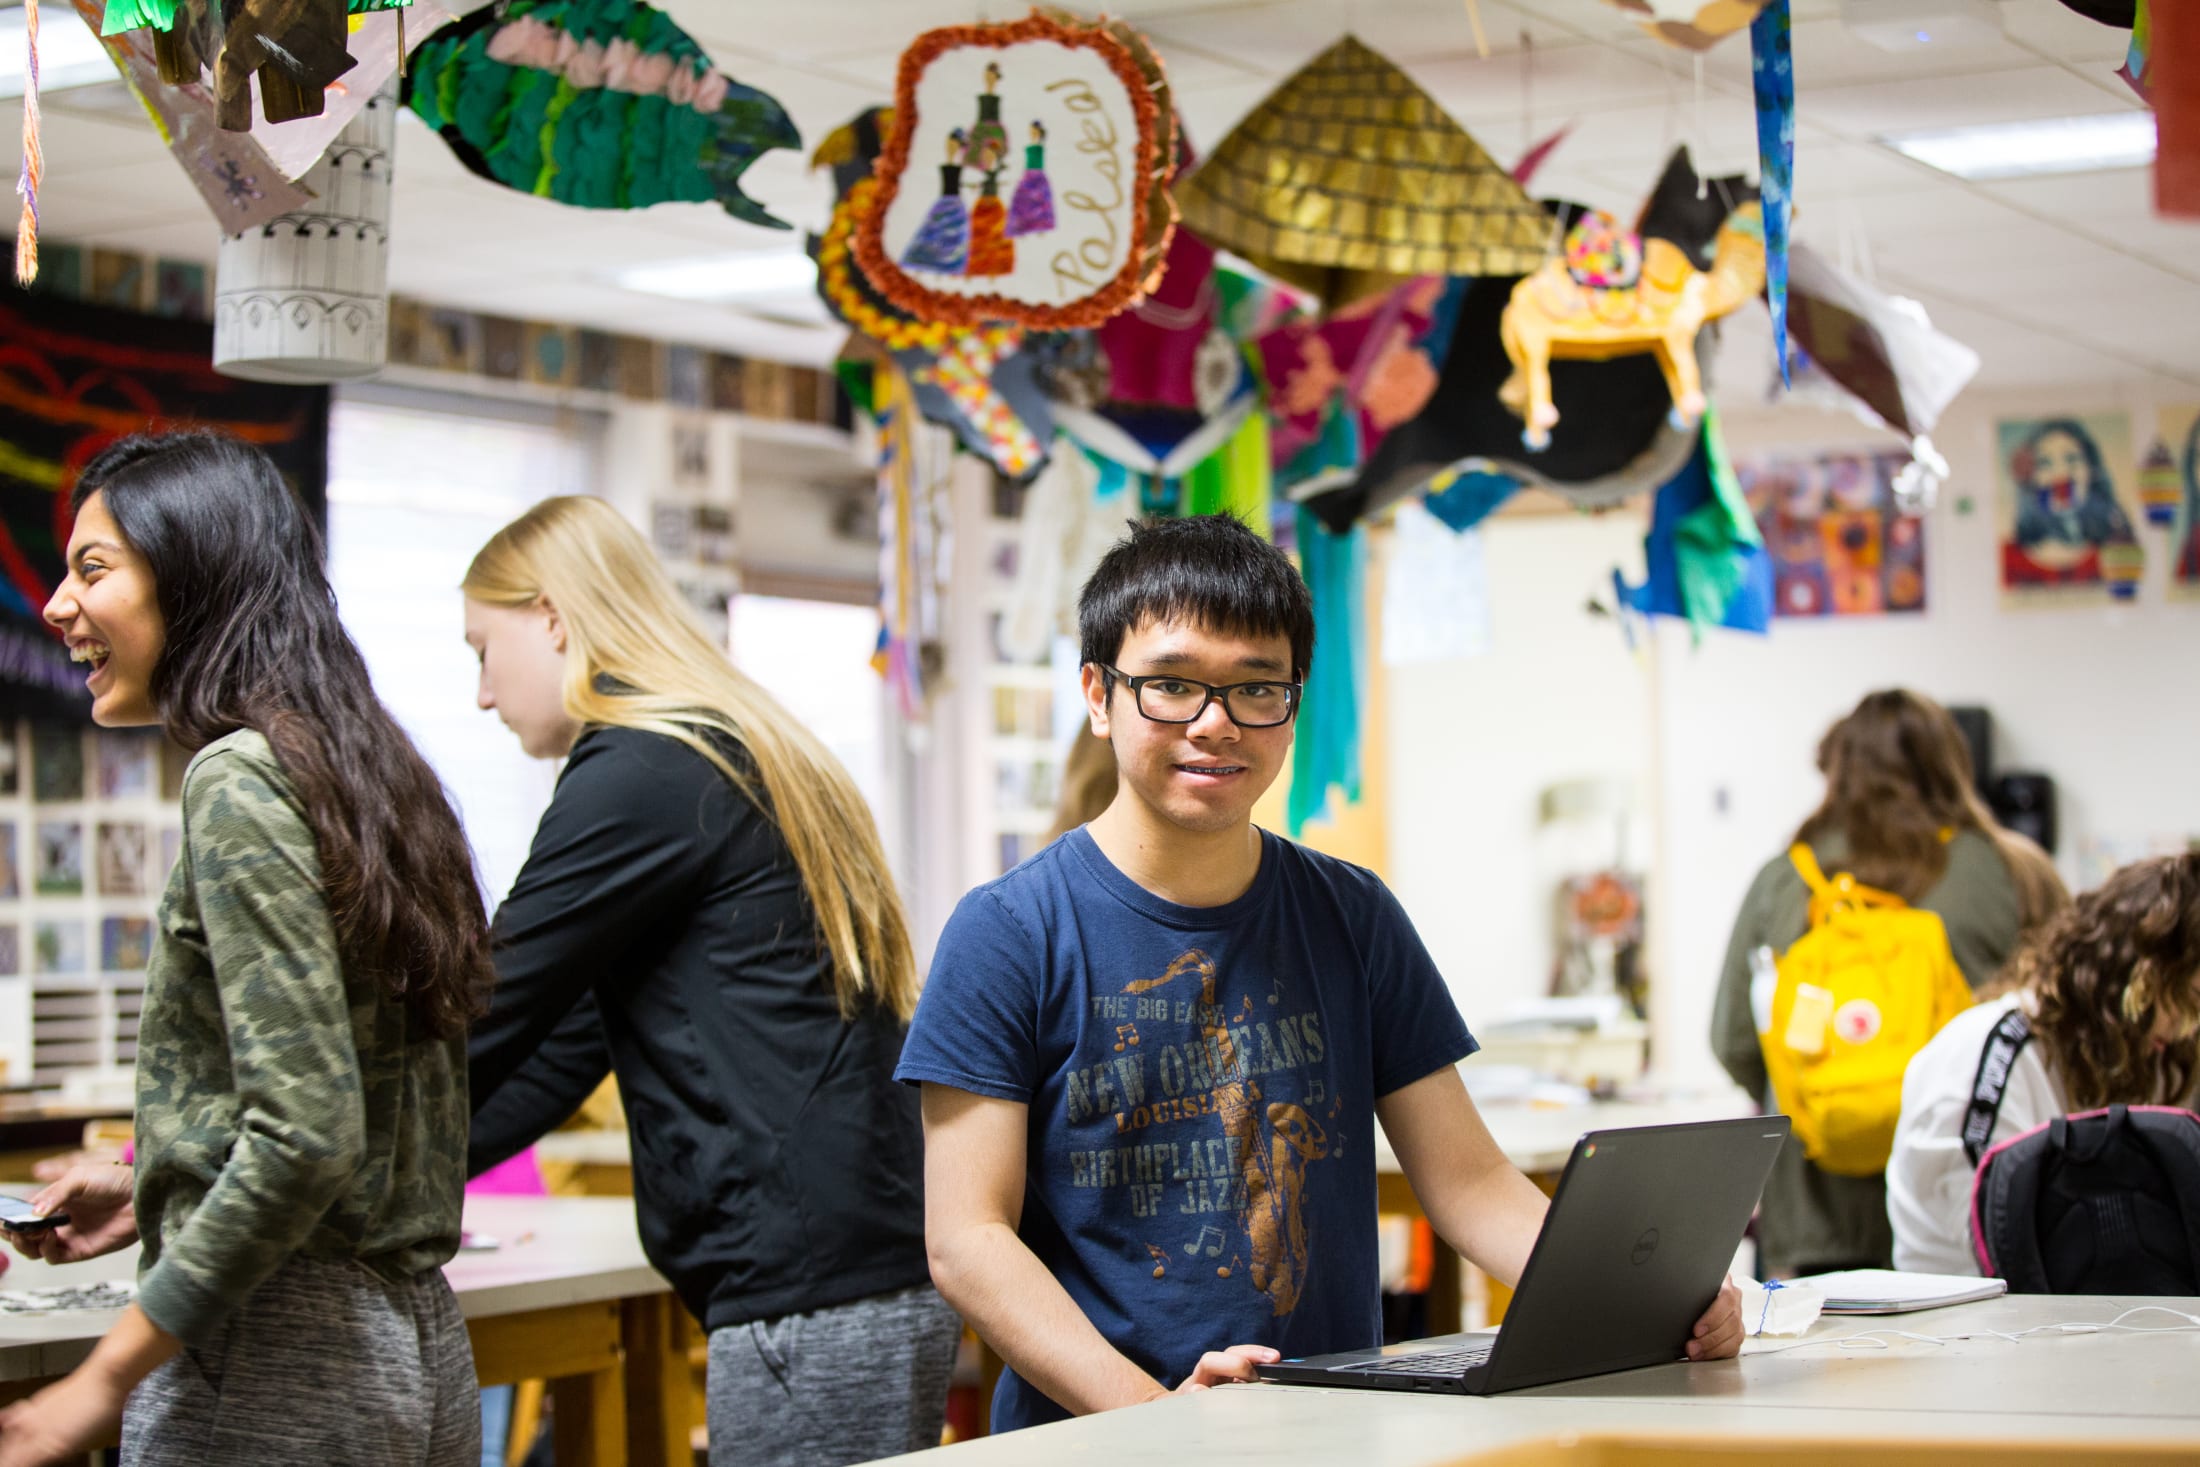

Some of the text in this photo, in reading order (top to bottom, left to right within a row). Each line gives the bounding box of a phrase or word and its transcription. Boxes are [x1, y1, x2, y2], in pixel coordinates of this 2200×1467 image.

[1091, 996, 1224, 1025] THE BIG EASY
[1066, 1012, 1325, 1124] NEW ORLEANS
[1069, 1136, 1243, 1188] BIRTHPLACE
[1130, 1176, 1247, 1217] OF JAZZ
